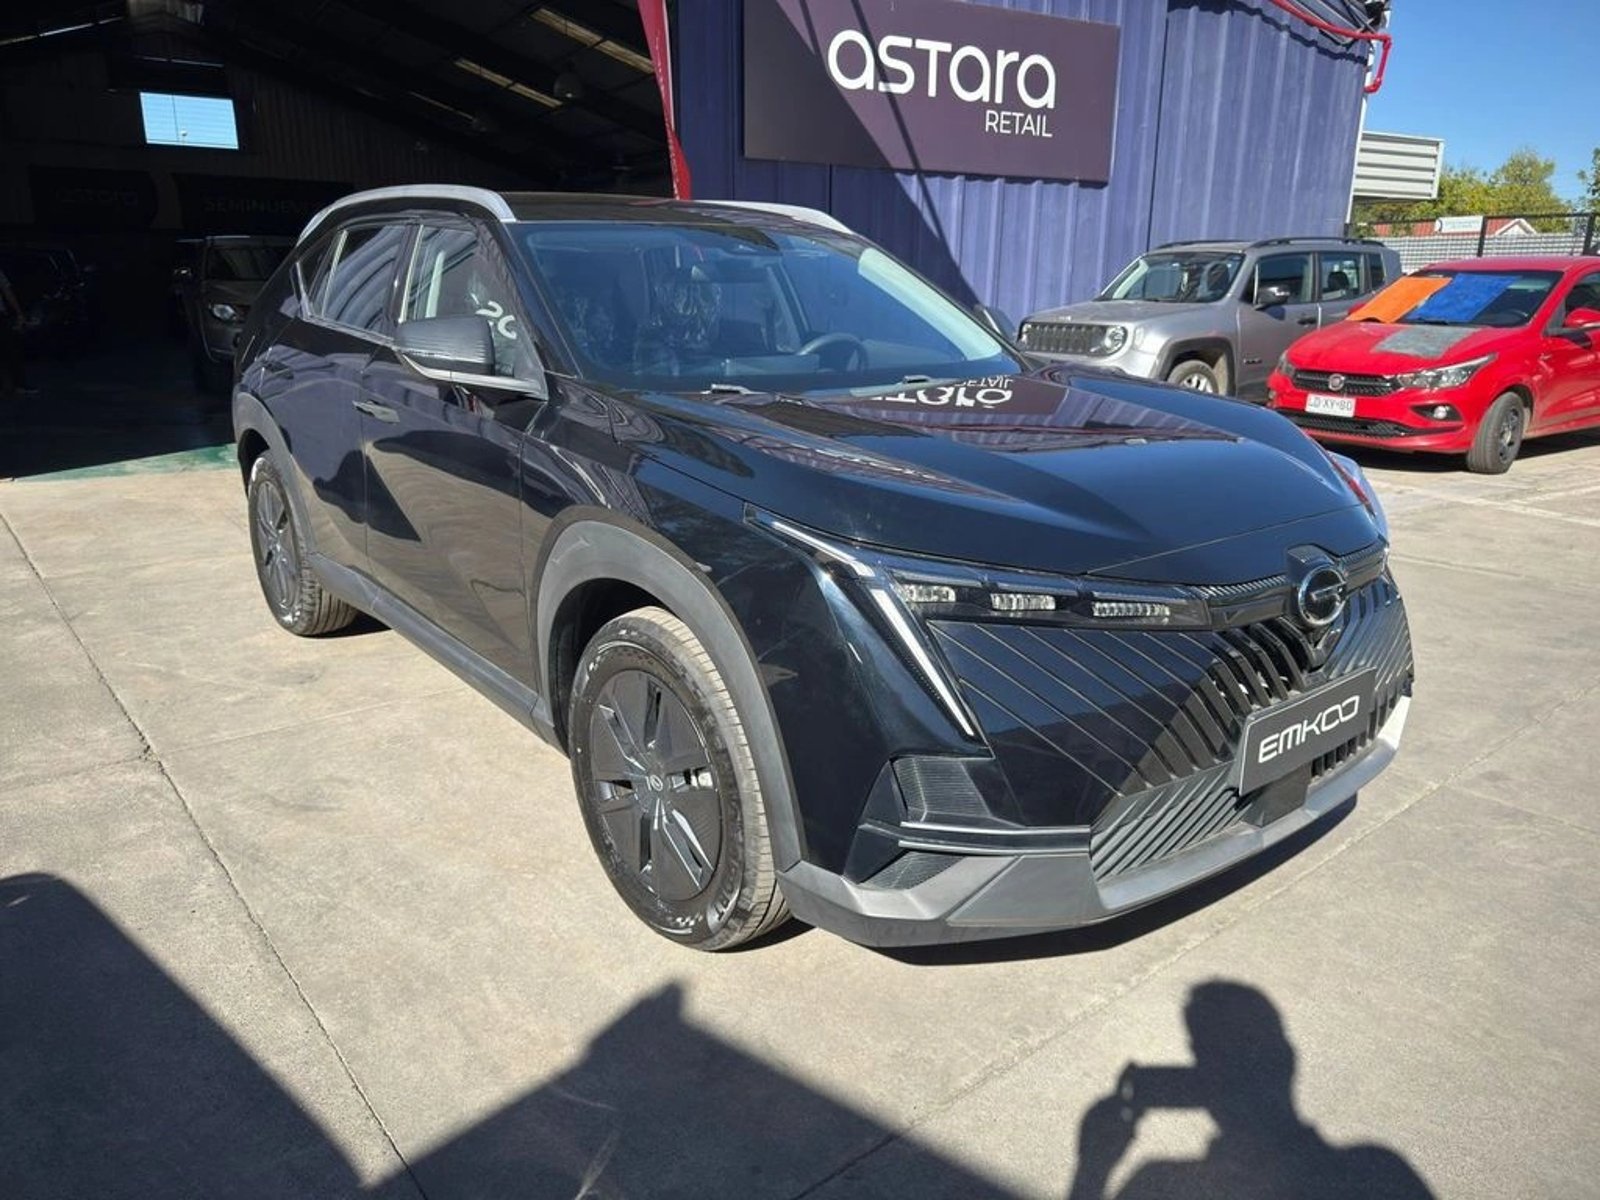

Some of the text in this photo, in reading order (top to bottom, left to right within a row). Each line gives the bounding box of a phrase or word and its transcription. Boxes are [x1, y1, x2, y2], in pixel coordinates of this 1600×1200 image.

[828, 29, 1056, 109] astara
[985, 110, 1053, 137] RETAIL
[1257, 695, 1361, 764] EMKOO
